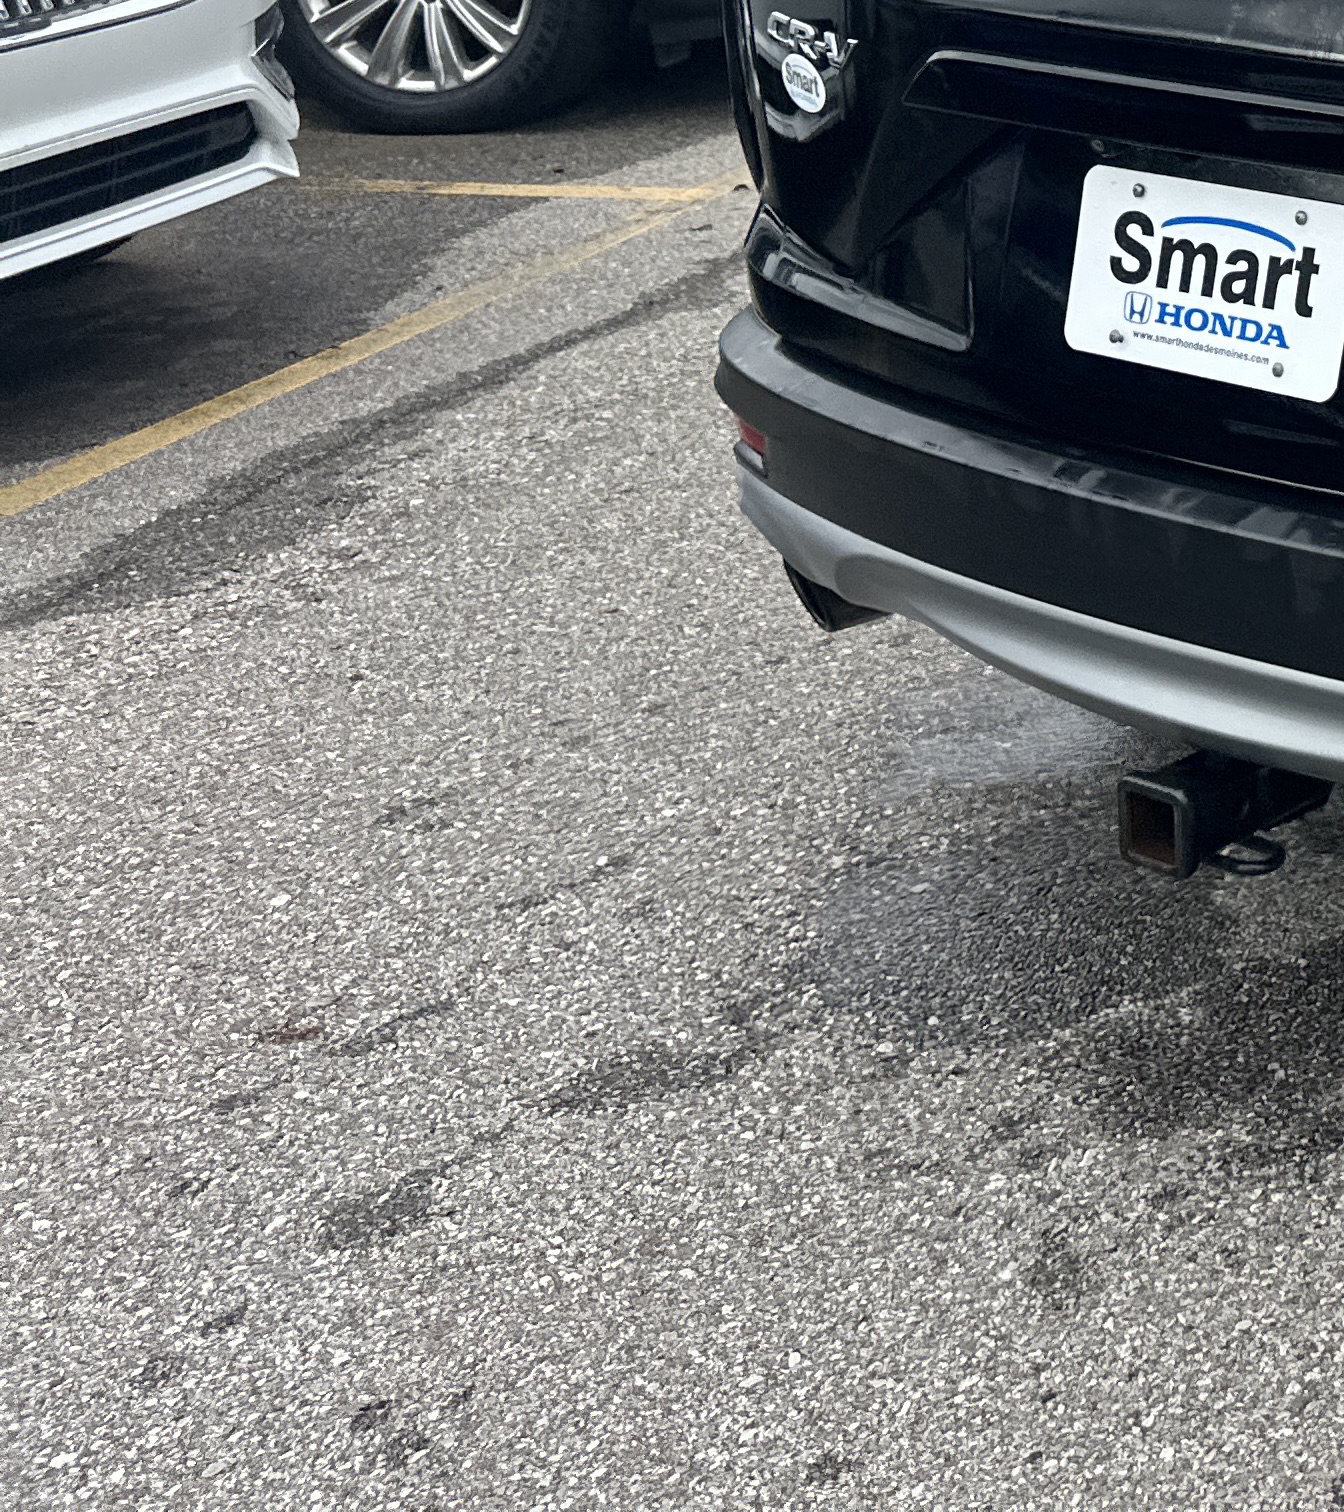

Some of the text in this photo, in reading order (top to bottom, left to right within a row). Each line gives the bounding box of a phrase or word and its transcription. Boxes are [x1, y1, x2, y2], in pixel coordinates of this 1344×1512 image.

[767, 11, 859, 69] CR-V
[785, 61, 820, 98] Smart
[1109, 210, 1320, 318] Smart
[1132, 330, 1269, 365] www.smarthondadesmoines.com
[1155, 301, 1290, 349] HONDA
